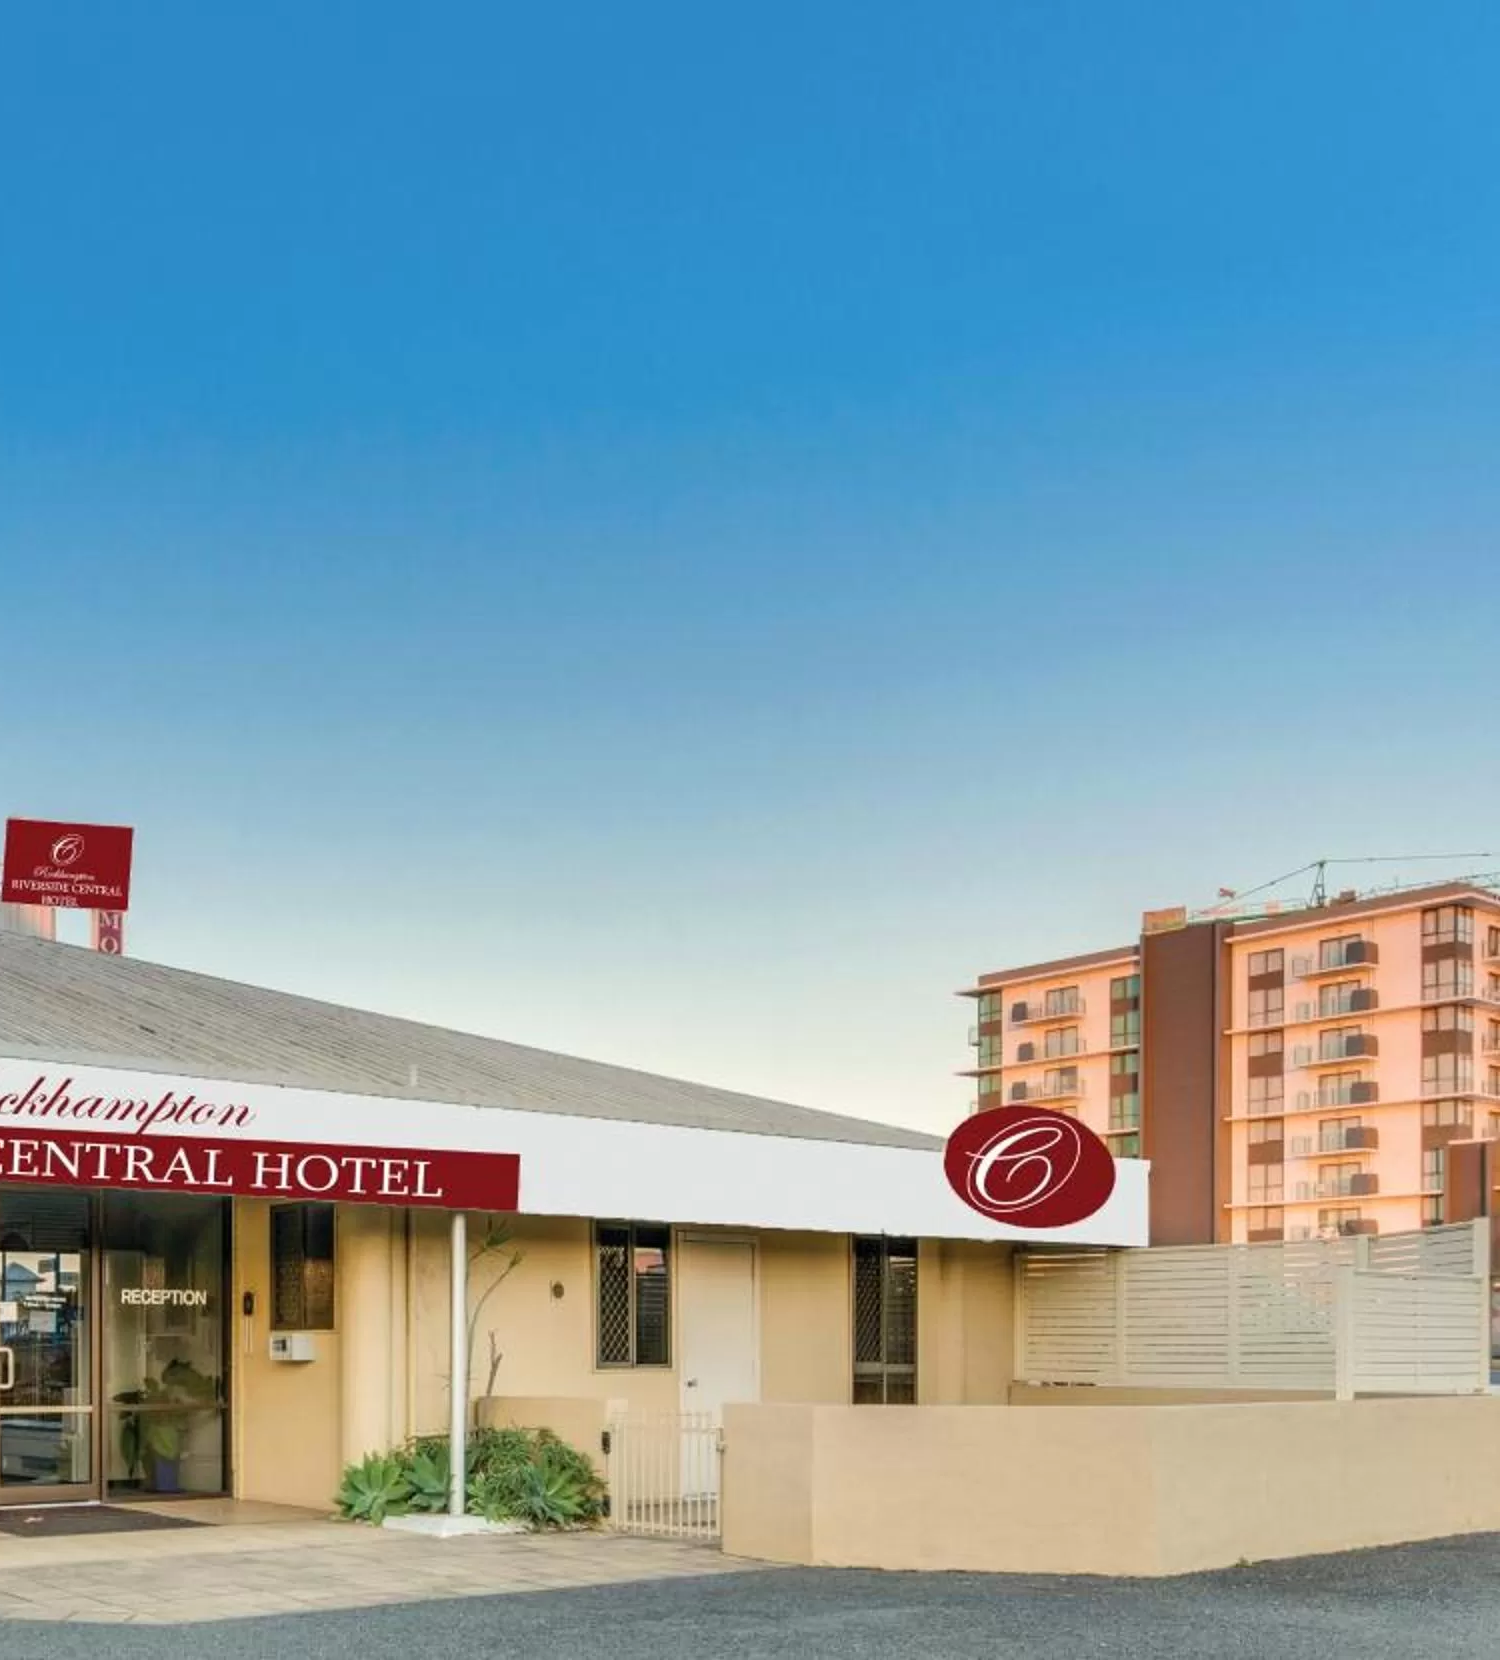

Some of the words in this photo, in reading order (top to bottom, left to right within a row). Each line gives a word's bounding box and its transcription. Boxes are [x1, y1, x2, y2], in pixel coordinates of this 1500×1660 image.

[11, 879, 69, 894] RIVERSIDE
[71, 883, 123, 897] CENTRAL
[251, 1151, 444, 1198] HOTEL
[964, 1116, 1081, 1213] C
[121, 1288, 207, 1307] RECEPTION
